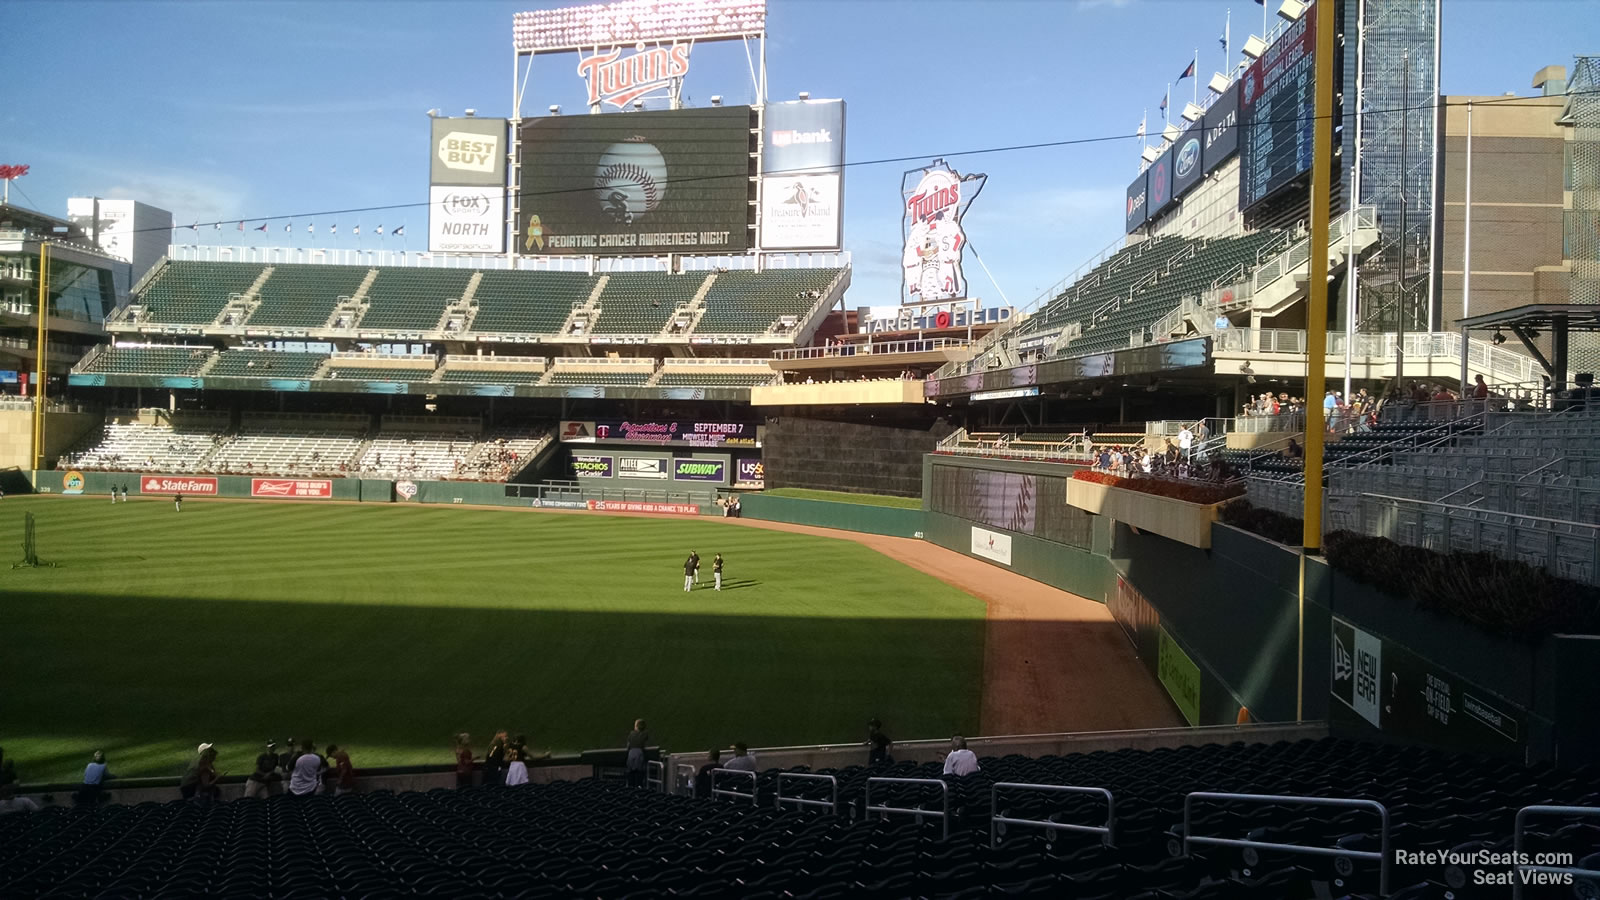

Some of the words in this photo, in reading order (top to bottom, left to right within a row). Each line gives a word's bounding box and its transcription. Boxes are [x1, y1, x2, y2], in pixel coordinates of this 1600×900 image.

[577, 41, 690, 105] Twins
[1213, 110, 1236, 141] DELTA
[447, 139, 494, 154] BEST
[447, 151, 489, 165] BUY
[452, 196, 479, 208] FOX
[907, 184, 958, 226] Twins
[1133, 188, 1146, 214] pepsi
[442, 222, 489, 236] NORTH
[549, 235, 597, 248] PEDIATRIC
[599, 234, 637, 247] CANCER
[639, 232, 698, 246] AWARENESS
[700, 231, 730, 245] NIGHT
[953, 306, 1012, 327] FIELD
[864, 315, 934, 333] TARGET
[619, 421, 668, 432] Promotions
[694, 423, 737, 433] SEPTEMBER
[738, 424, 744, 434] 7
[682, 433, 708, 441] MIDWEST
[572, 462, 608, 471] STACHIOS
[676, 463, 722, 475] SUBWAY
[407, 485, 416, 493] 29
[595, 501, 606, 510] 25
[914, 531, 924, 539] 403
[1357, 648, 1377, 680] NEW
[1357, 672, 1376, 705] ERA
[1425, 686, 1450, 713] ON-FIELD
